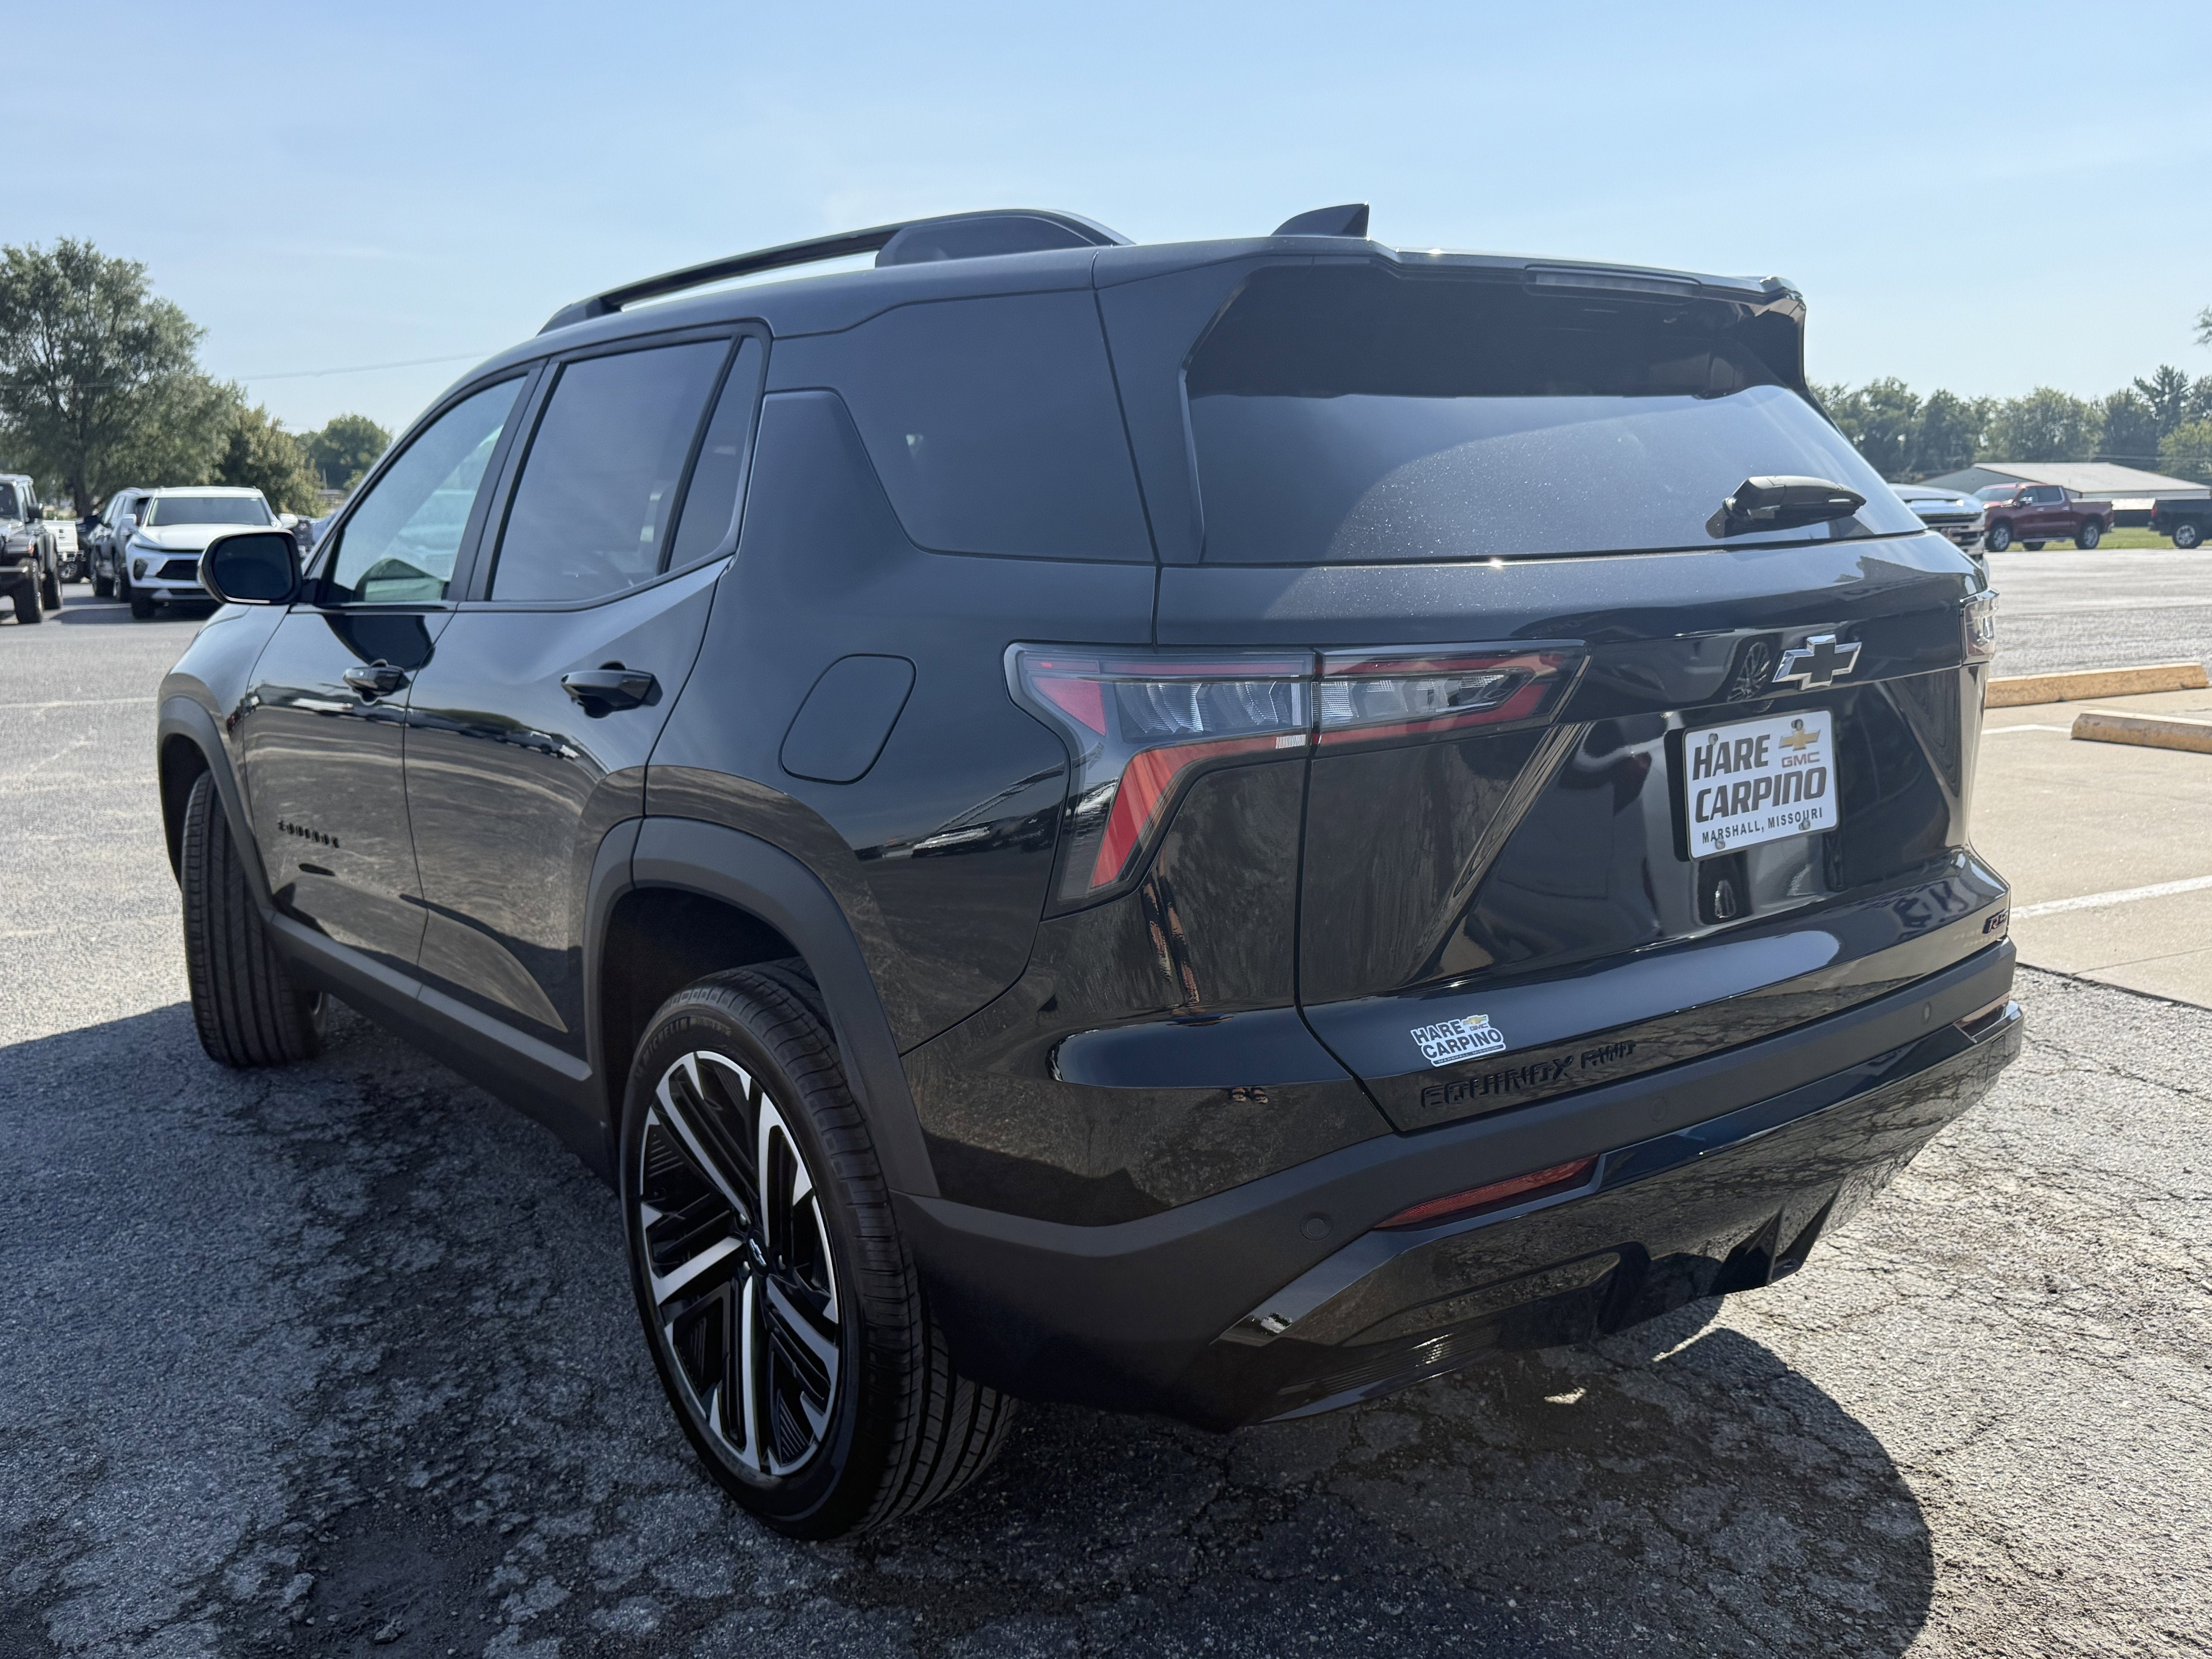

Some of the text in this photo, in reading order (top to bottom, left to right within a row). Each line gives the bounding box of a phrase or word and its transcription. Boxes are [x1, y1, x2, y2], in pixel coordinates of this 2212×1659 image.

[1692, 734, 1771, 781] HARE
[1782, 751, 1820, 768] GMC
[1695, 766, 1827, 823] CARPINO
[1702, 807, 1822, 844] MARSHALL, MISSOURI
[1413, 1021, 1465, 1044] HARE
[1423, 1029, 1502, 1058] CARPINO
[1469, 1023, 1489, 1031] GMC
[1420, 1055, 1574, 1109] EQUINOX
